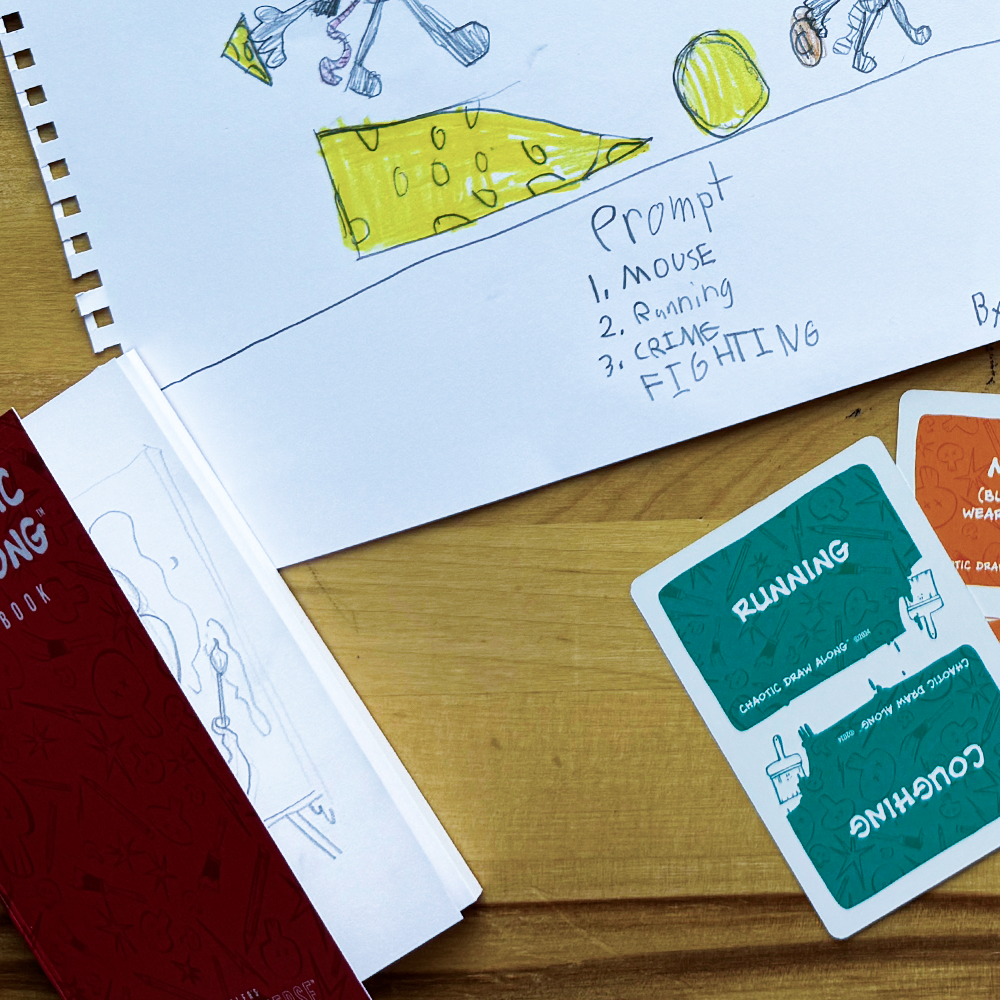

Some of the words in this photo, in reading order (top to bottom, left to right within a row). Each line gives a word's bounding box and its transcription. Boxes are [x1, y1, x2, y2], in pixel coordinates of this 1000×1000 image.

[591, 161, 733, 252] Prompt
[622, 243, 716, 290] MOUSE
[599, 315, 624, 338] 2.
[633, 277, 734, 325] Running
[598, 354, 624, 378] 3.
[634, 321, 720, 360] CRIME
[640, 320, 820, 402] FIGHTING
[732, 539, 851, 624] RUNNING
[739, 682, 782, 714] CHAOTIC
[783, 663, 812, 688] DRAW
[896, 684, 925, 709] DRAW
[927, 657, 970, 689] CHAOTIC
[848, 743, 986, 840] COUGHING
